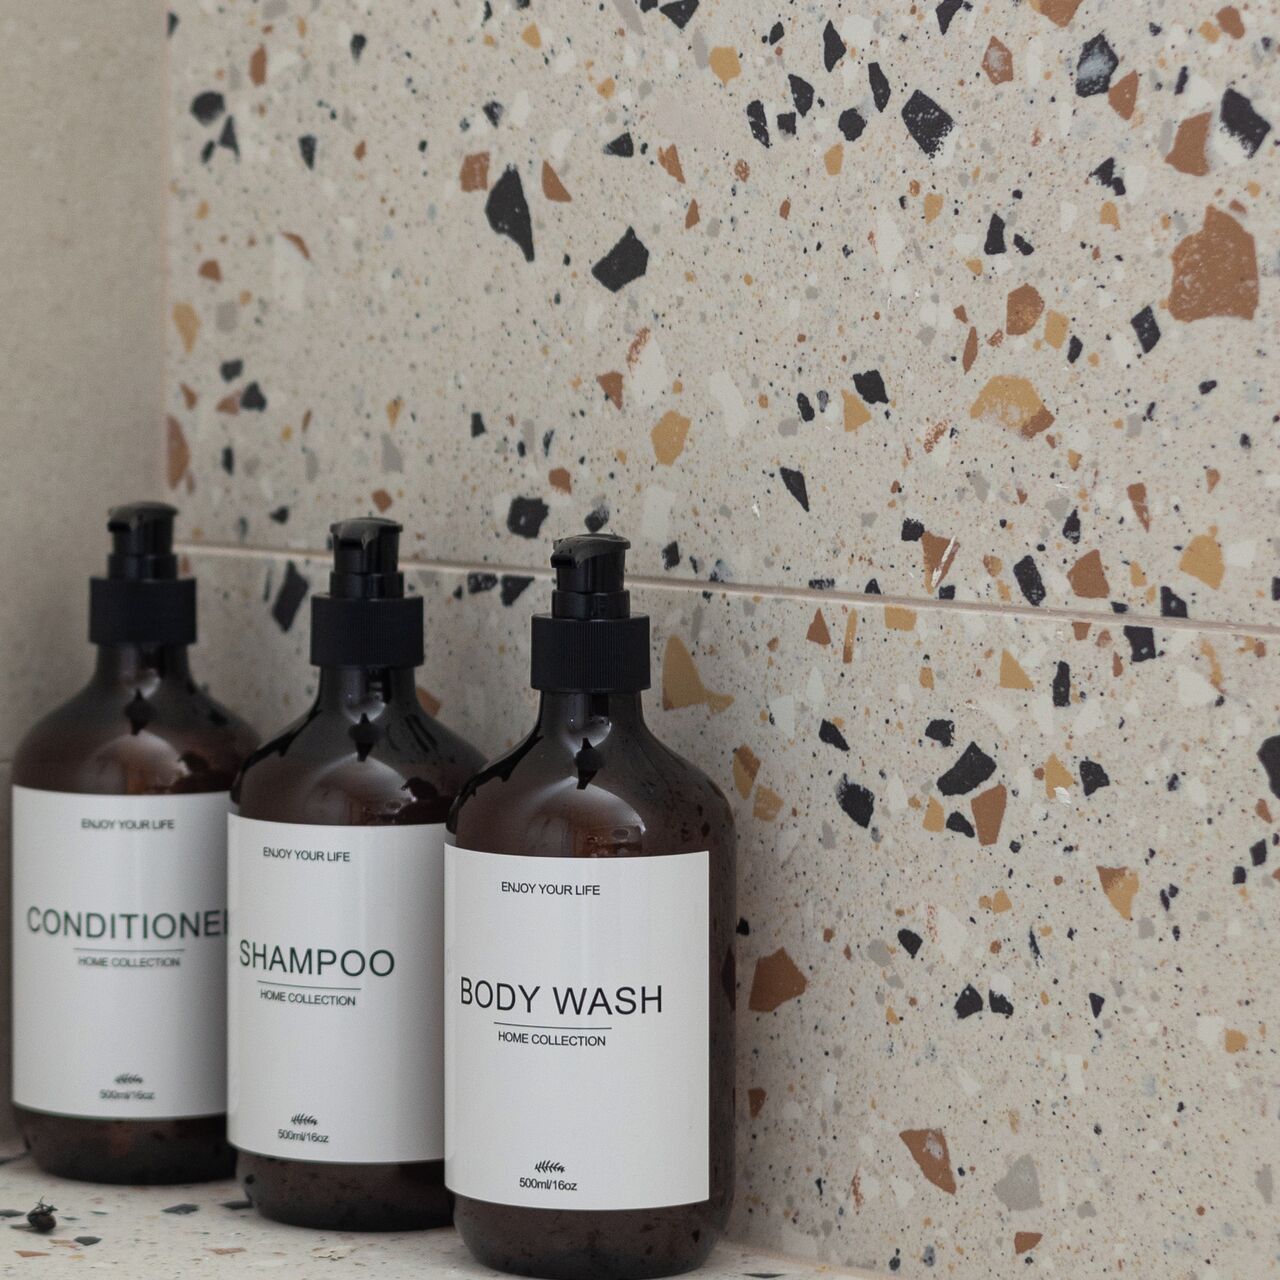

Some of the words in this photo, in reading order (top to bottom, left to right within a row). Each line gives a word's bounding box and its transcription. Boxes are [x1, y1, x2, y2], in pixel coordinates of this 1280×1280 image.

[81, 818, 115, 829] ENJOY
[119, 819, 150, 830] YOUR
[152, 819, 174, 829] LIFE
[263, 846, 292, 859] ENJOY
[294, 849, 325, 861] YOUR
[327, 850, 350, 862] LIFE
[501, 881, 536, 894] ENJOY
[538, 883, 573, 895] YOUR
[575, 884, 600, 895] LIFE
[78, 955, 108, 968] HOME
[112, 956, 180, 968] COLLECTION
[240, 939, 395, 977] SHAMPOO
[260, 989, 286, 1002] HOME
[288, 992, 355, 1007] COLLECTION
[461, 976, 540, 1013] BODY
[553, 985, 662, 1015] WASH
[498, 1031, 529, 1044] HOME
[532, 1033, 606, 1046] COLLECTION
[278, 1129, 329, 1143] 500ml/16oz
[519, 1177, 577, 1191] 500ml/16oz
